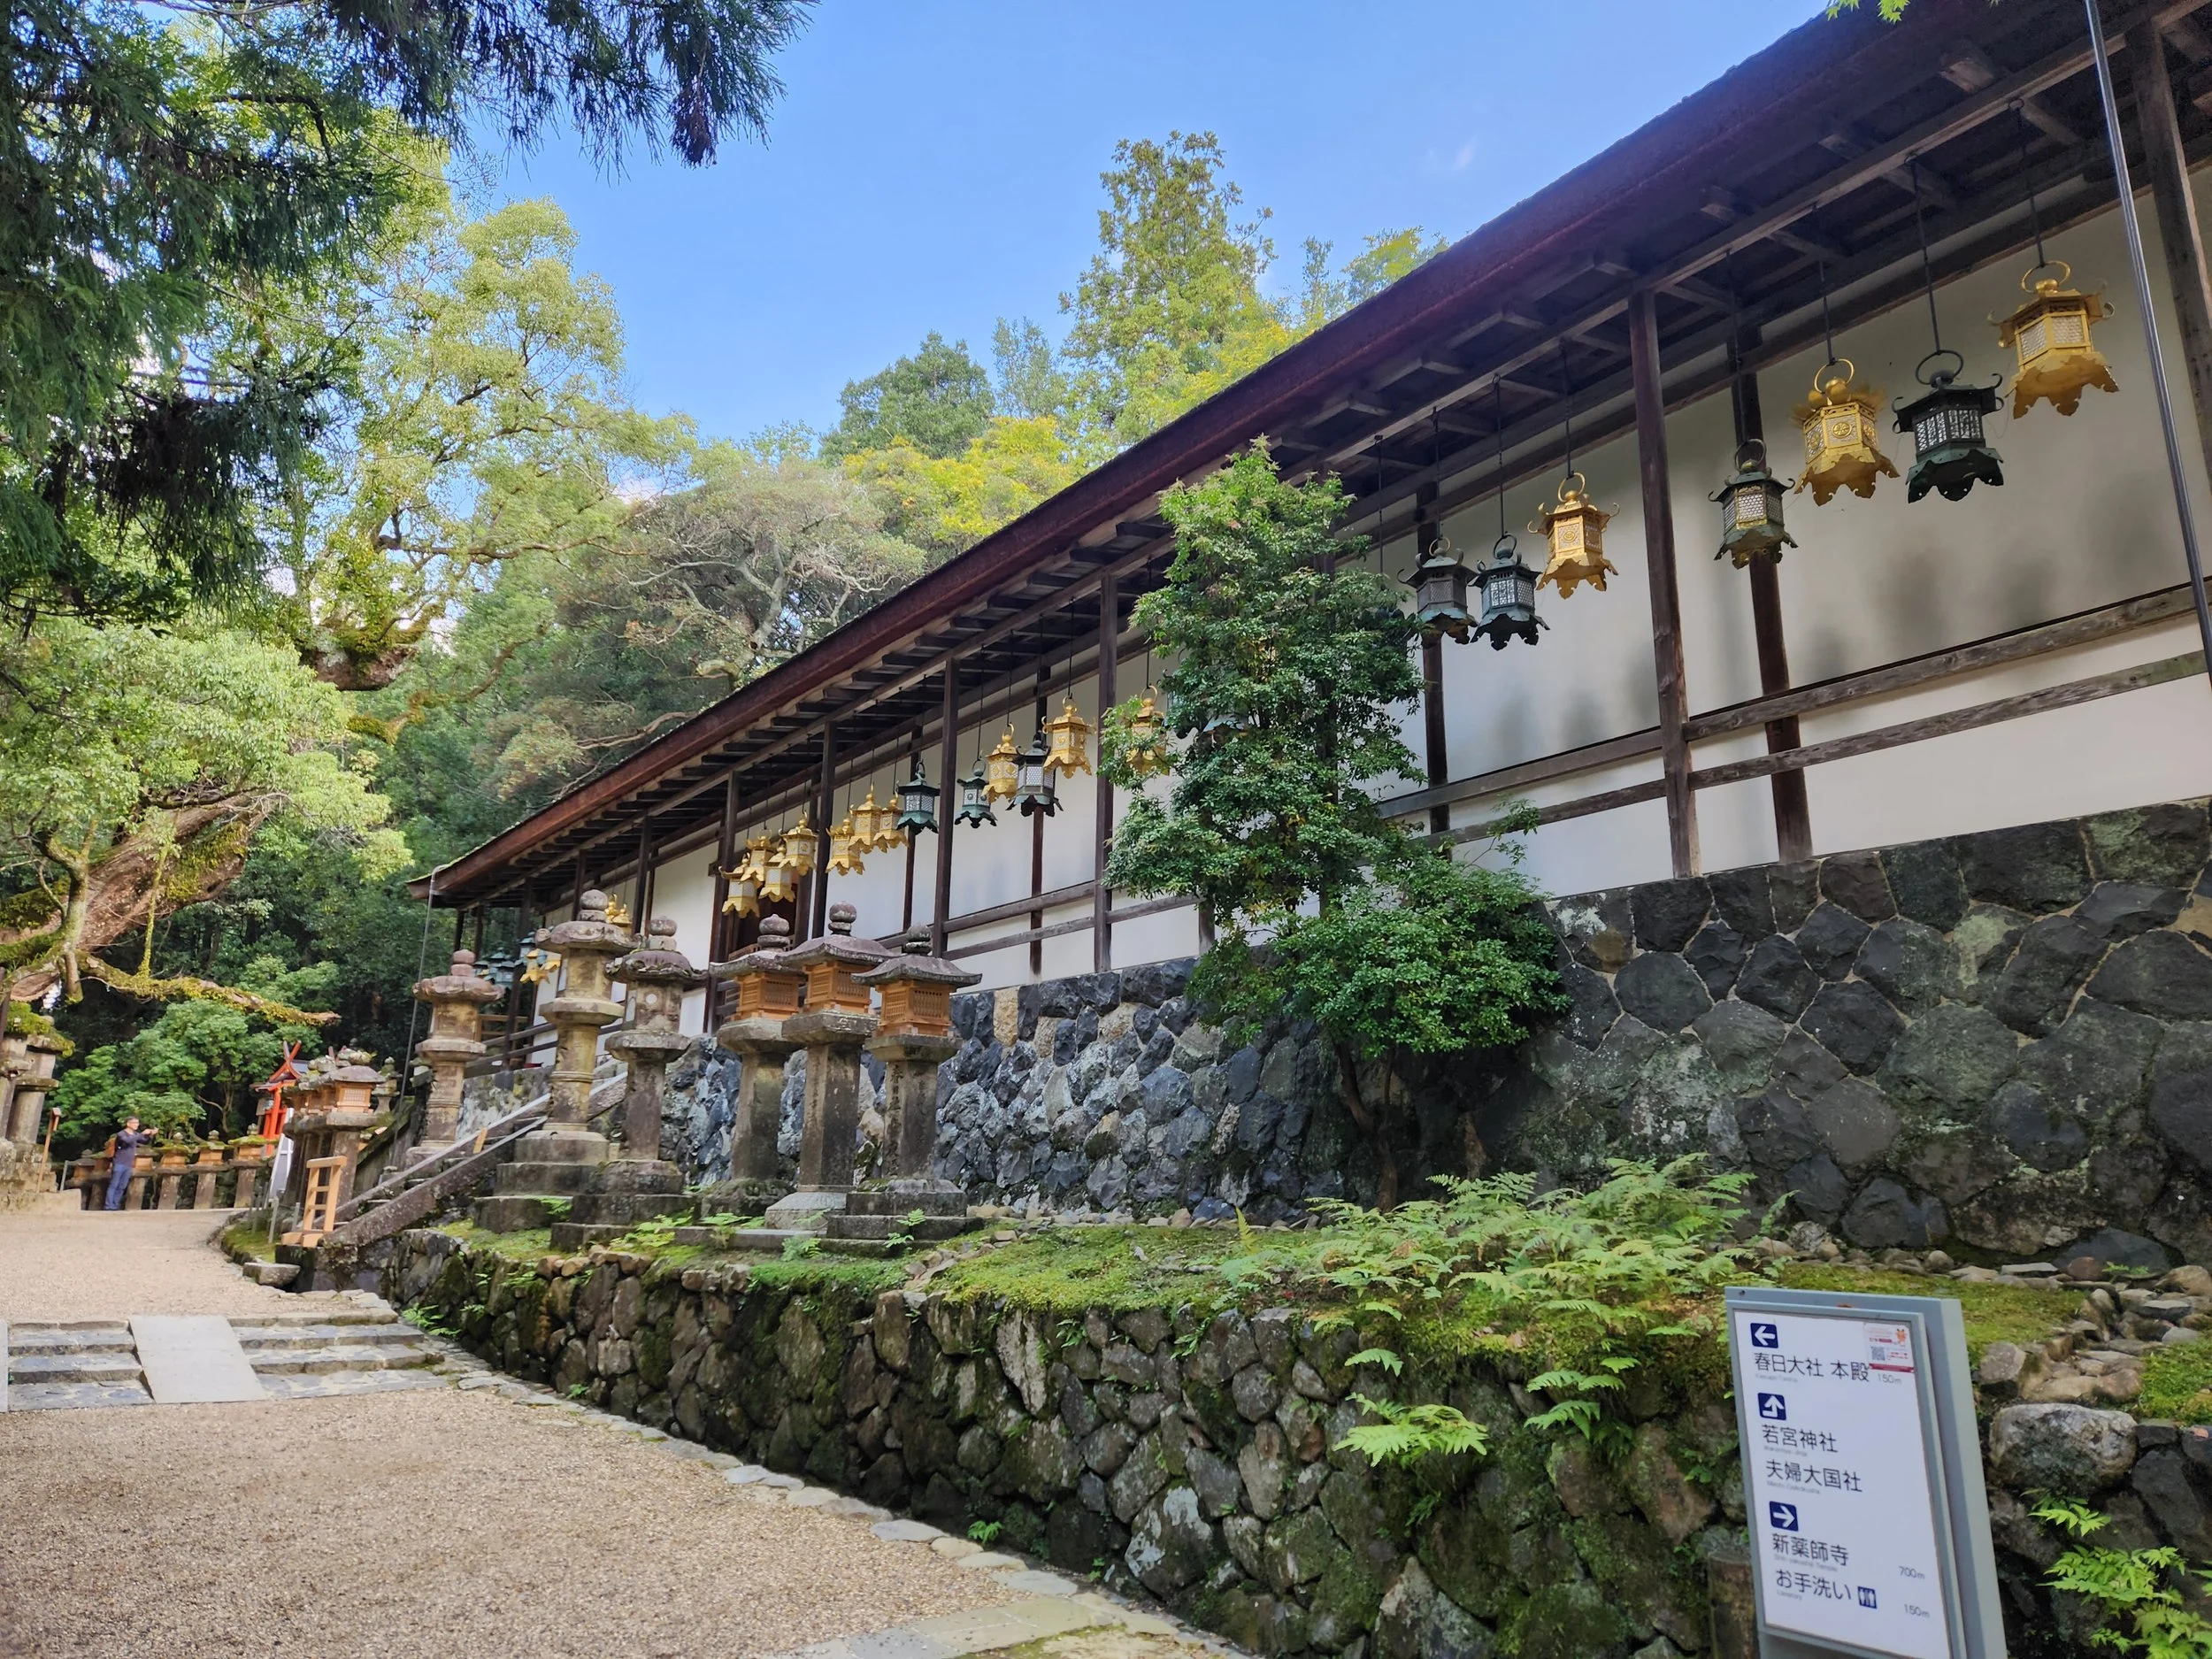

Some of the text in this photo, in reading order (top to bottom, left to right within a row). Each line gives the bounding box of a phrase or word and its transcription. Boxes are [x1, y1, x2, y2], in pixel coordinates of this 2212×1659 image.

[1754, 1352, 1824, 1378] 春日大社
[1830, 1360, 1870, 1382] 本殿
[1878, 1373, 1902, 1385] 150m
[1762, 1424, 1839, 1453] 若宮神社
[1766, 1459, 1863, 1493] 夫婦大国社
[1771, 1532, 1849, 1567] 新薬師寺
[1899, 1566, 1925, 1580] 700m
[1776, 1569, 1852, 1601] お手洗い
[1903, 1603, 1931, 1619] 150m
